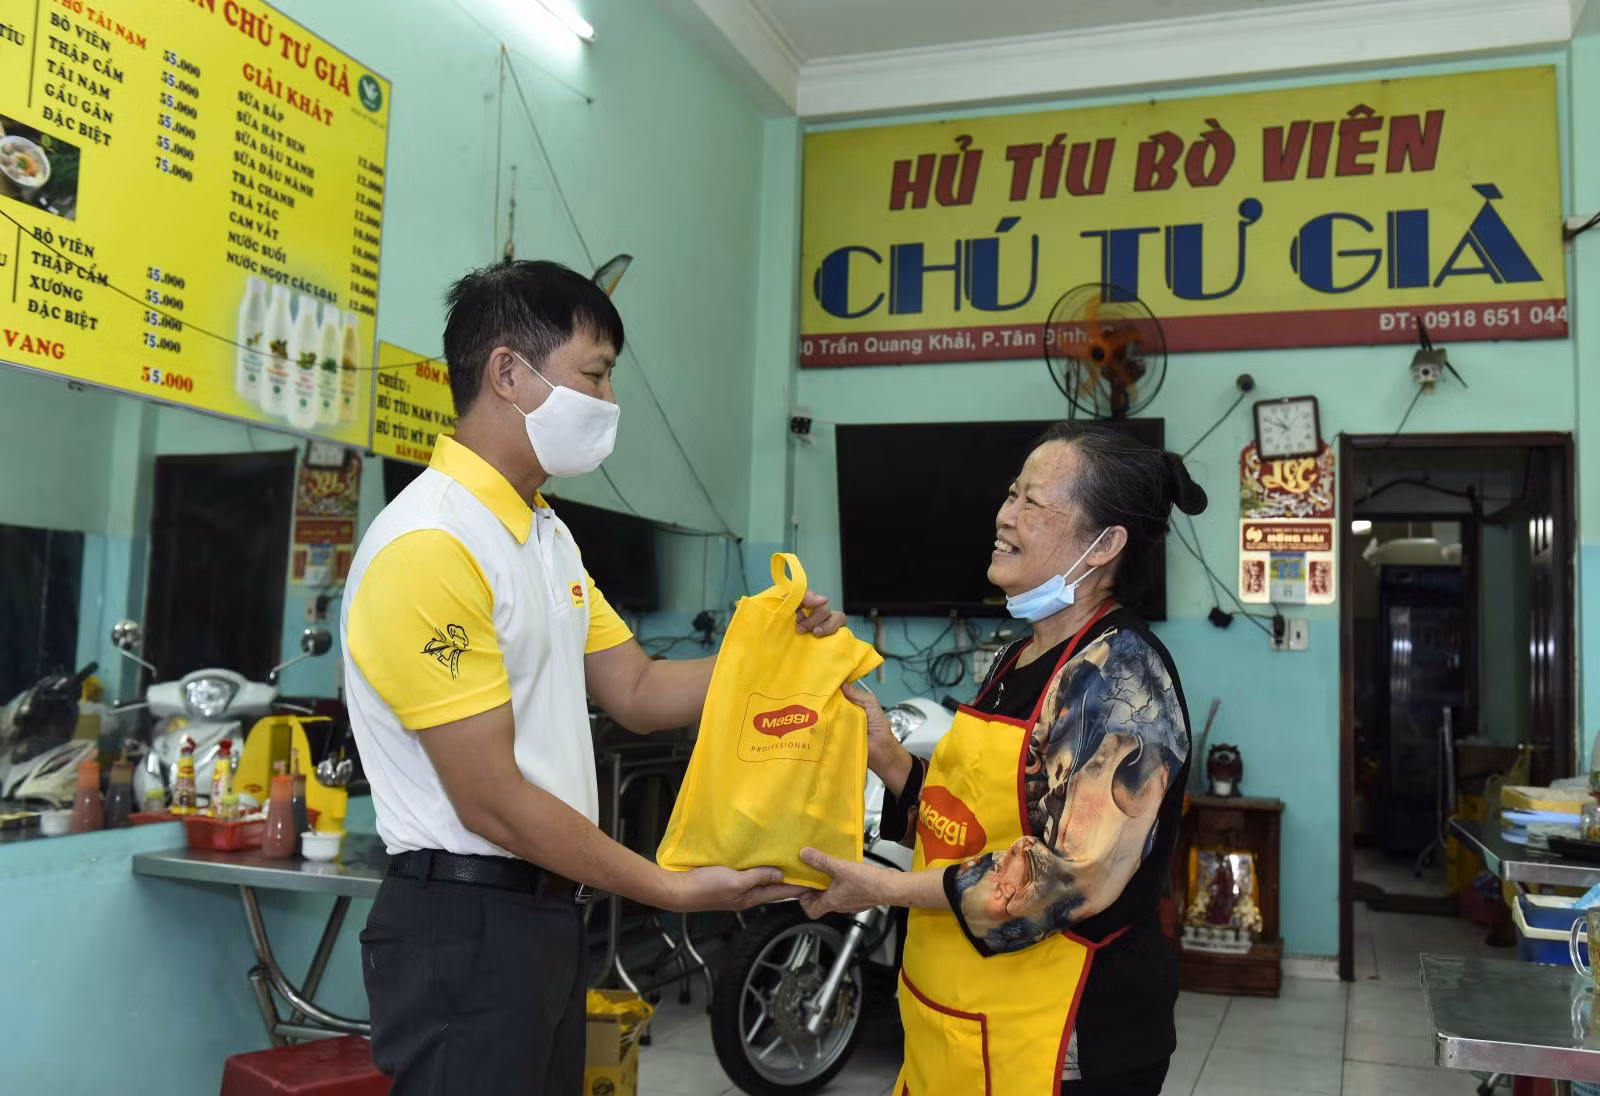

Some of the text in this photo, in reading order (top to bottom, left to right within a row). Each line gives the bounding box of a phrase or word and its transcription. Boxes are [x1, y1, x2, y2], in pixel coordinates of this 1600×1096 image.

[50, 11, 111, 53] BÒ VIÊN
[49, 35, 90, 64] THẬP
[223, 0, 351, 97] CHÚ TƯ GIÀ
[46, 58, 111, 100] TÁI NẠM
[242, 62, 283, 99] GIẢI
[286, 86, 334, 127] KHÁT
[42, 105, 112, 147] ĐẶC BIỆT
[155, 155, 193, 182] 75.000
[285, 155, 315, 180] XANH
[889, 103, 1446, 211] HỦ TÍU BÒ VIÊN
[257, 182, 295, 208] CHANH
[229, 210, 254, 231] CAM
[33, 226, 95, 259] BÒ VIÊN
[813, 183, 1544, 319] CHÚ TƯ GIÀ
[31, 250, 73, 275] THẬP
[29, 274, 83, 302] XƯƠNG
[146, 266, 185, 290] 55.000
[290, 276, 313, 295] CÁC
[145, 288, 184, 311] 55.000
[27, 298, 99, 331] ĐẶC BIỆT
[143, 310, 182, 333] 55.000
[1379, 305, 1568, 331] ĐT: 0918 651 044
[143, 332, 181, 354] 75.000
[864, 336, 923, 356] Quang
[982, 329, 1037, 348] P.Tân
[141, 364, 193, 393] 55.000
[761, 713, 810, 729] Maggi
[750, 742, 811, 753] PROFESSIONAL
[919, 800, 968, 847] Maggi
